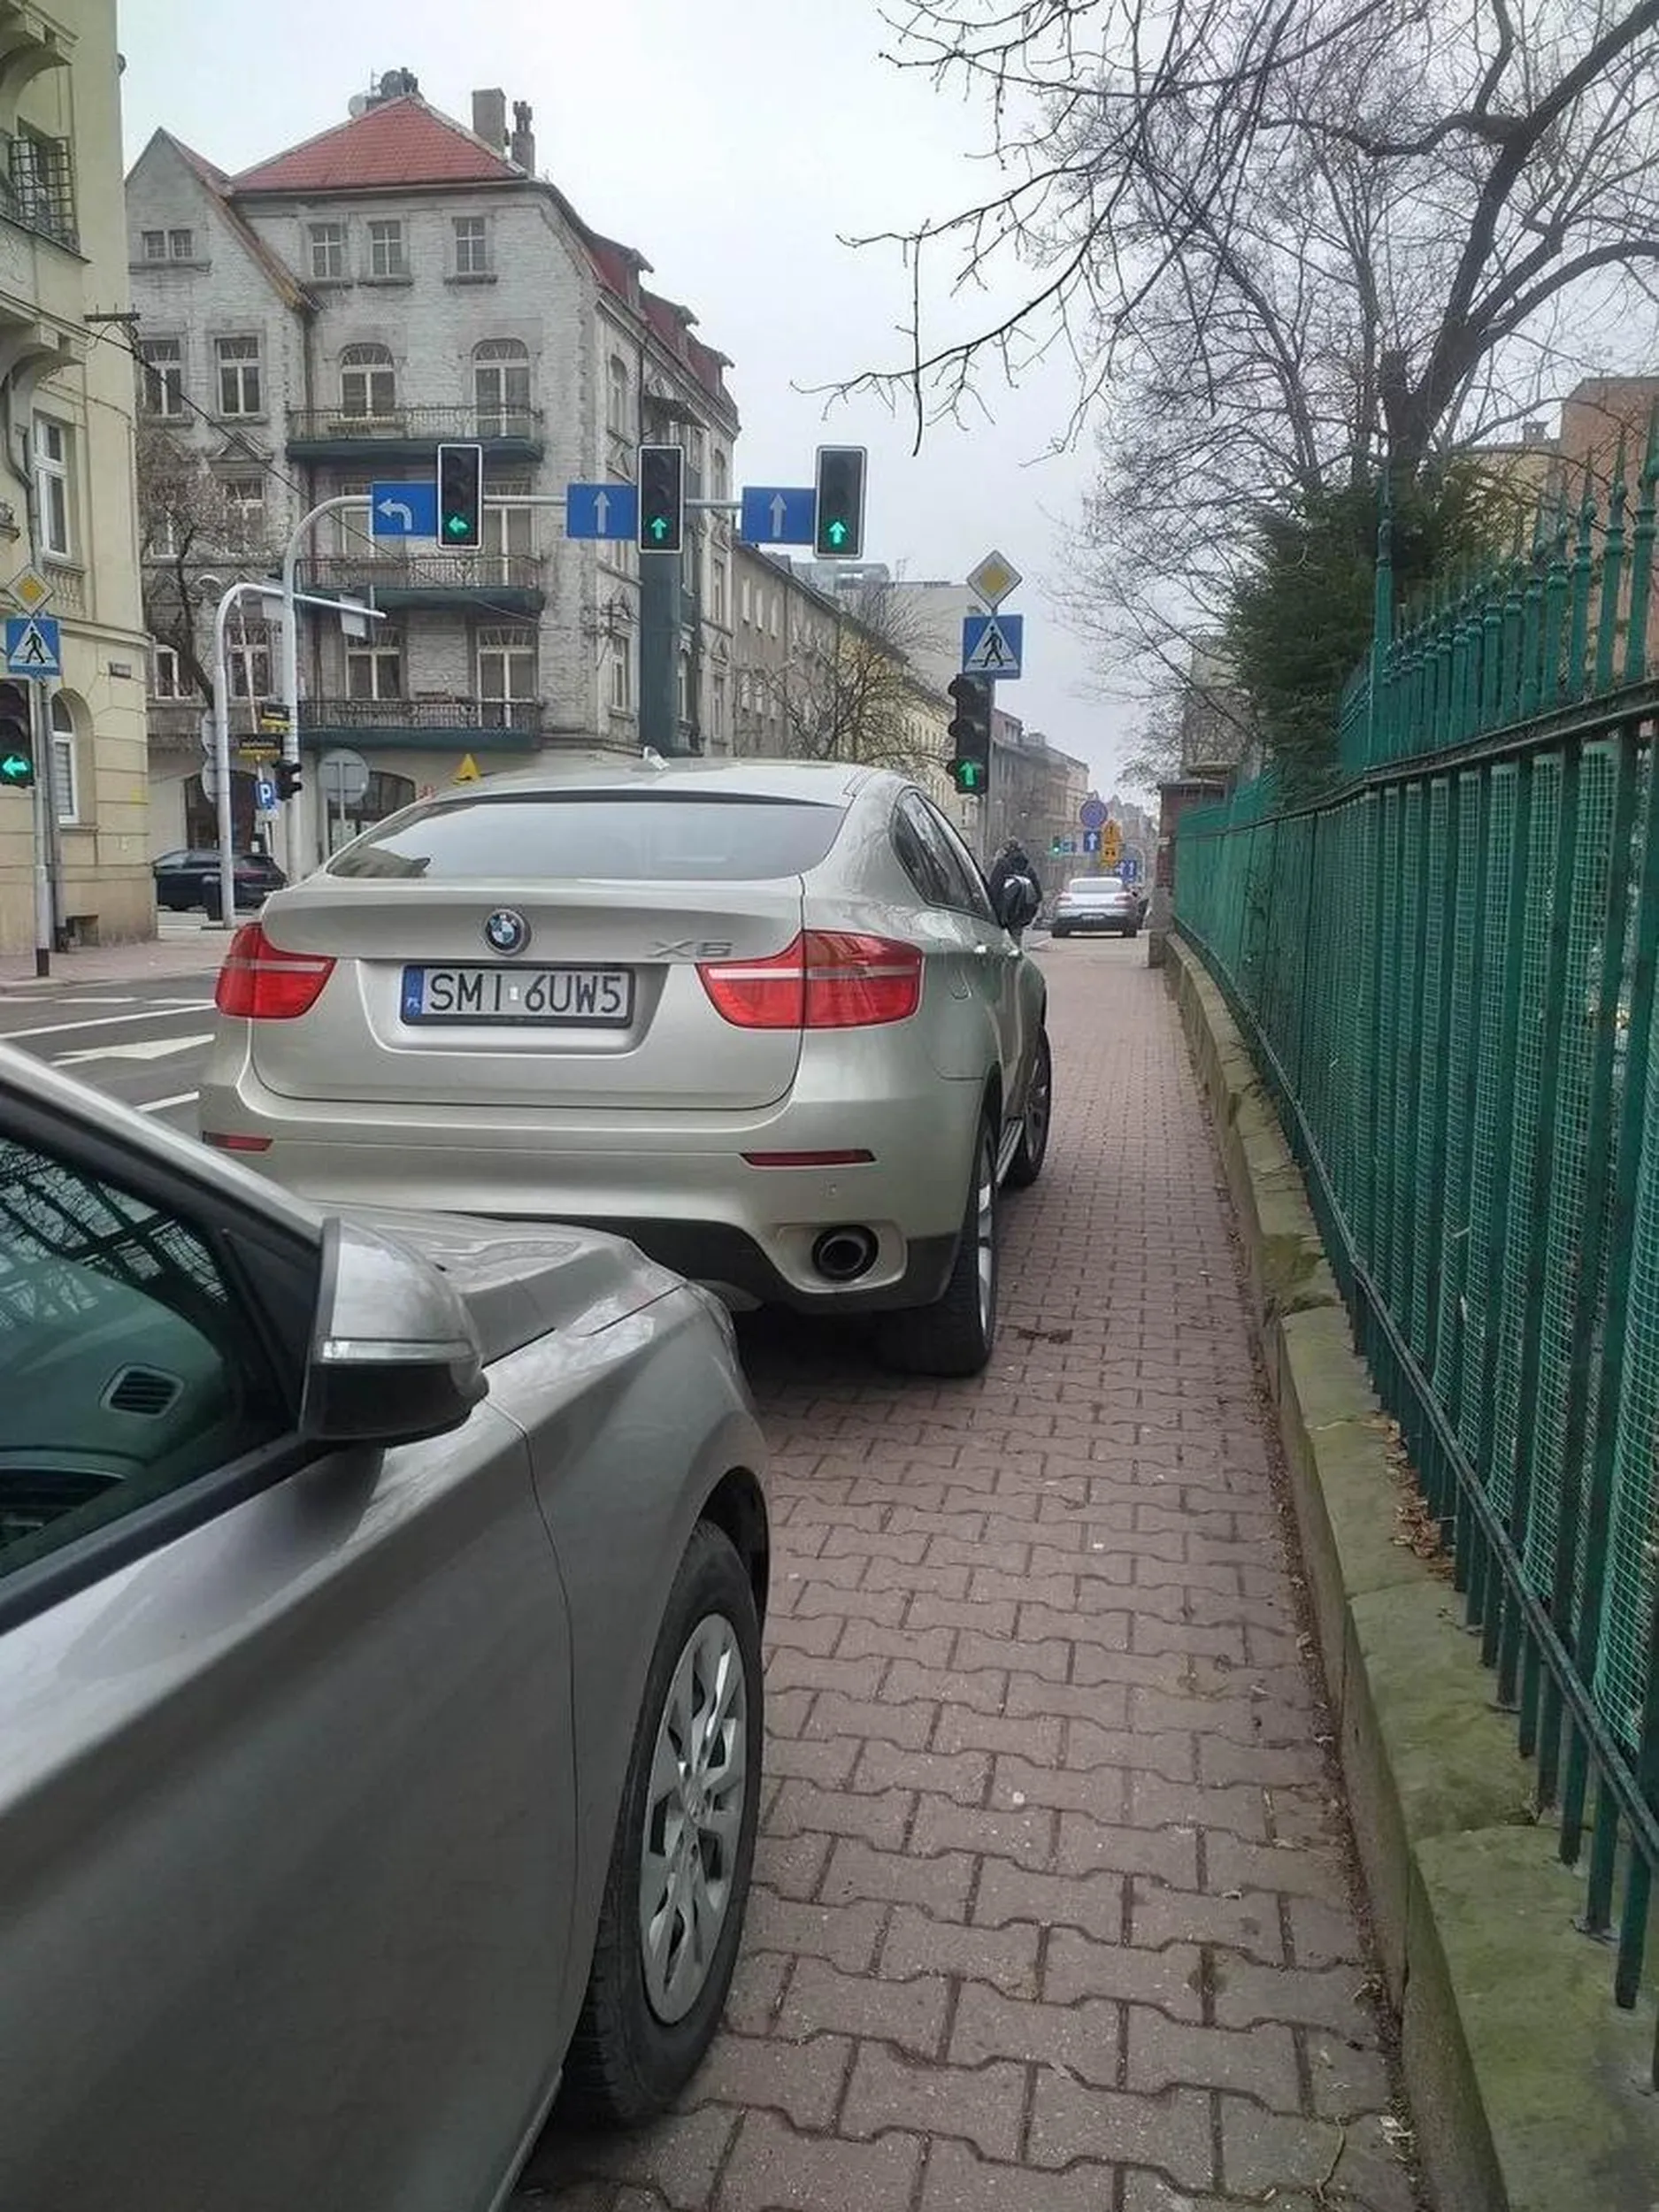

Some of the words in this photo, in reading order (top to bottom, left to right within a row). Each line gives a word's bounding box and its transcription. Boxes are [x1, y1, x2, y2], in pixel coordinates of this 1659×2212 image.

[260, 783, 271, 804] P
[430, 972, 503, 1011] SMI
[525, 974, 621, 1013] 6UW5
